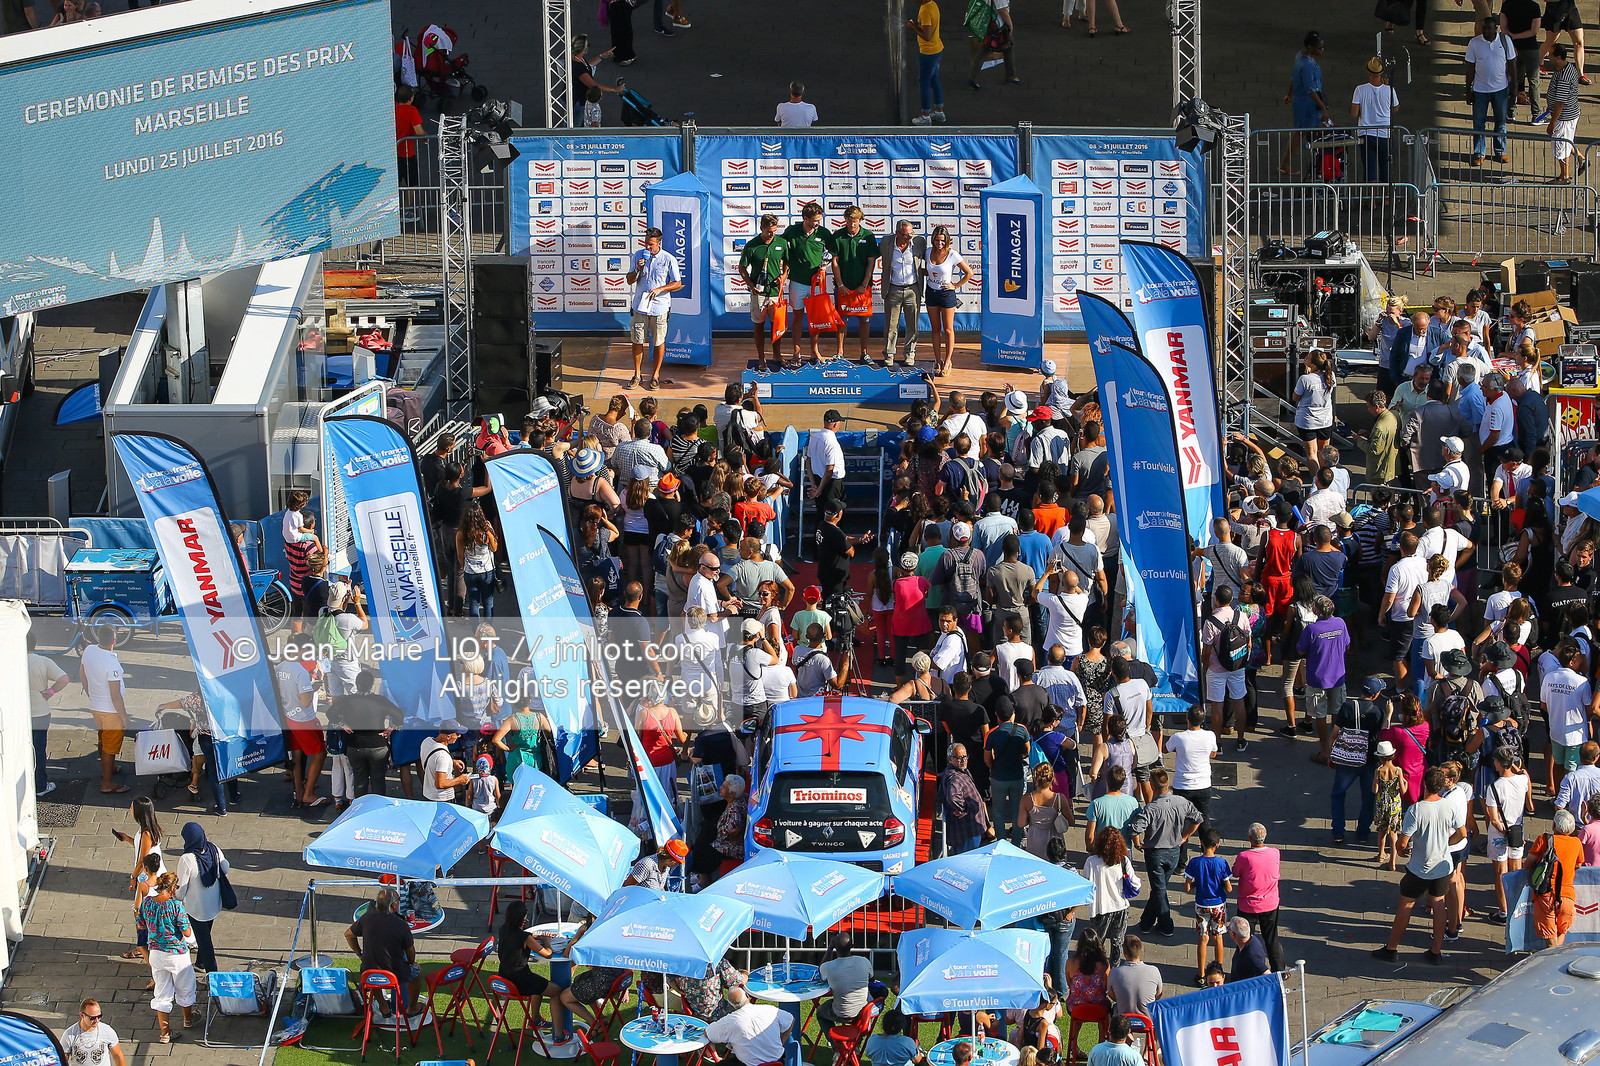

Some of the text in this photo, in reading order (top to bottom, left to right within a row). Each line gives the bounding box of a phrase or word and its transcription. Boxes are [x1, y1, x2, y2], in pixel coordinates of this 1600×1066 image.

[25, 41, 355, 125] CEREMONIE DE REMISE DES PRIX
[134, 95, 249, 136] MARSEILLE
[587, 143, 610, 151] JUILLET
[858, 147, 877, 155] voile
[1110, 143, 1134, 151] JUILLET
[104, 130, 284, 181] LUNDI 25 JUILLET 2016
[1010, 219, 1022, 278] FINAGAZ
[1173, 279, 1197, 287] france
[1170, 286, 1199, 297] voile
[39, 293, 67, 308] voile
[809, 386, 862, 395] MARSEILLE
[1166, 332, 1196, 440] YANMAR
[354, 454, 372, 463] tour
[381, 446, 407, 457] france
[379, 454, 410, 467] voile
[145, 470, 163, 479] tour
[172, 461, 199, 474] france
[1132, 461, 1176, 474] #TourVoile
[171, 469, 202, 484] voile
[510, 472, 556, 497] tour france
[531, 479, 558, 495] voile
[1165, 518, 1182, 529] voile
[385, 511, 417, 601] MARSEILLE
[177, 517, 225, 626] YANMAR
[406, 532, 428, 610] www.marseille.fr
[1141, 569, 1187, 581] @TourVoile
[384, 564, 399, 602] VILLE DE
[275, 671, 291, 680] CREW
[148, 743, 171, 761] H&M
[237, 755, 266, 768] @TourVoile
[793, 790, 863, 802] Triominos
[803, 819, 808, 827] à
[808, 821, 831, 829] gagner
[843, 820, 868, 829] chaque
[381, 834, 405, 844] voile
[387, 828, 407, 837] france
[452, 836, 474, 860] @TourVoile
[347, 857, 398, 872] @TourVoile
[524, 855, 572, 892] @TourVoile
[1004, 870, 1043, 885] tour france
[1025, 874, 1047, 886] voile
[747, 881, 786, 895] tour france
[761, 890, 783, 901] voile
[832, 898, 862, 920] @TourVoile
[920, 893, 953, 918] @TourVoile
[1010, 900, 1057, 919] @TourVoile
[649, 931, 674, 940] voile
[655, 925, 677, 933] france
[614, 954, 669, 970] @TourVoile
[973, 968, 999, 977] voile
[942, 996, 1000, 1009] @TourVoile
[24, 1046, 54, 1058] france
